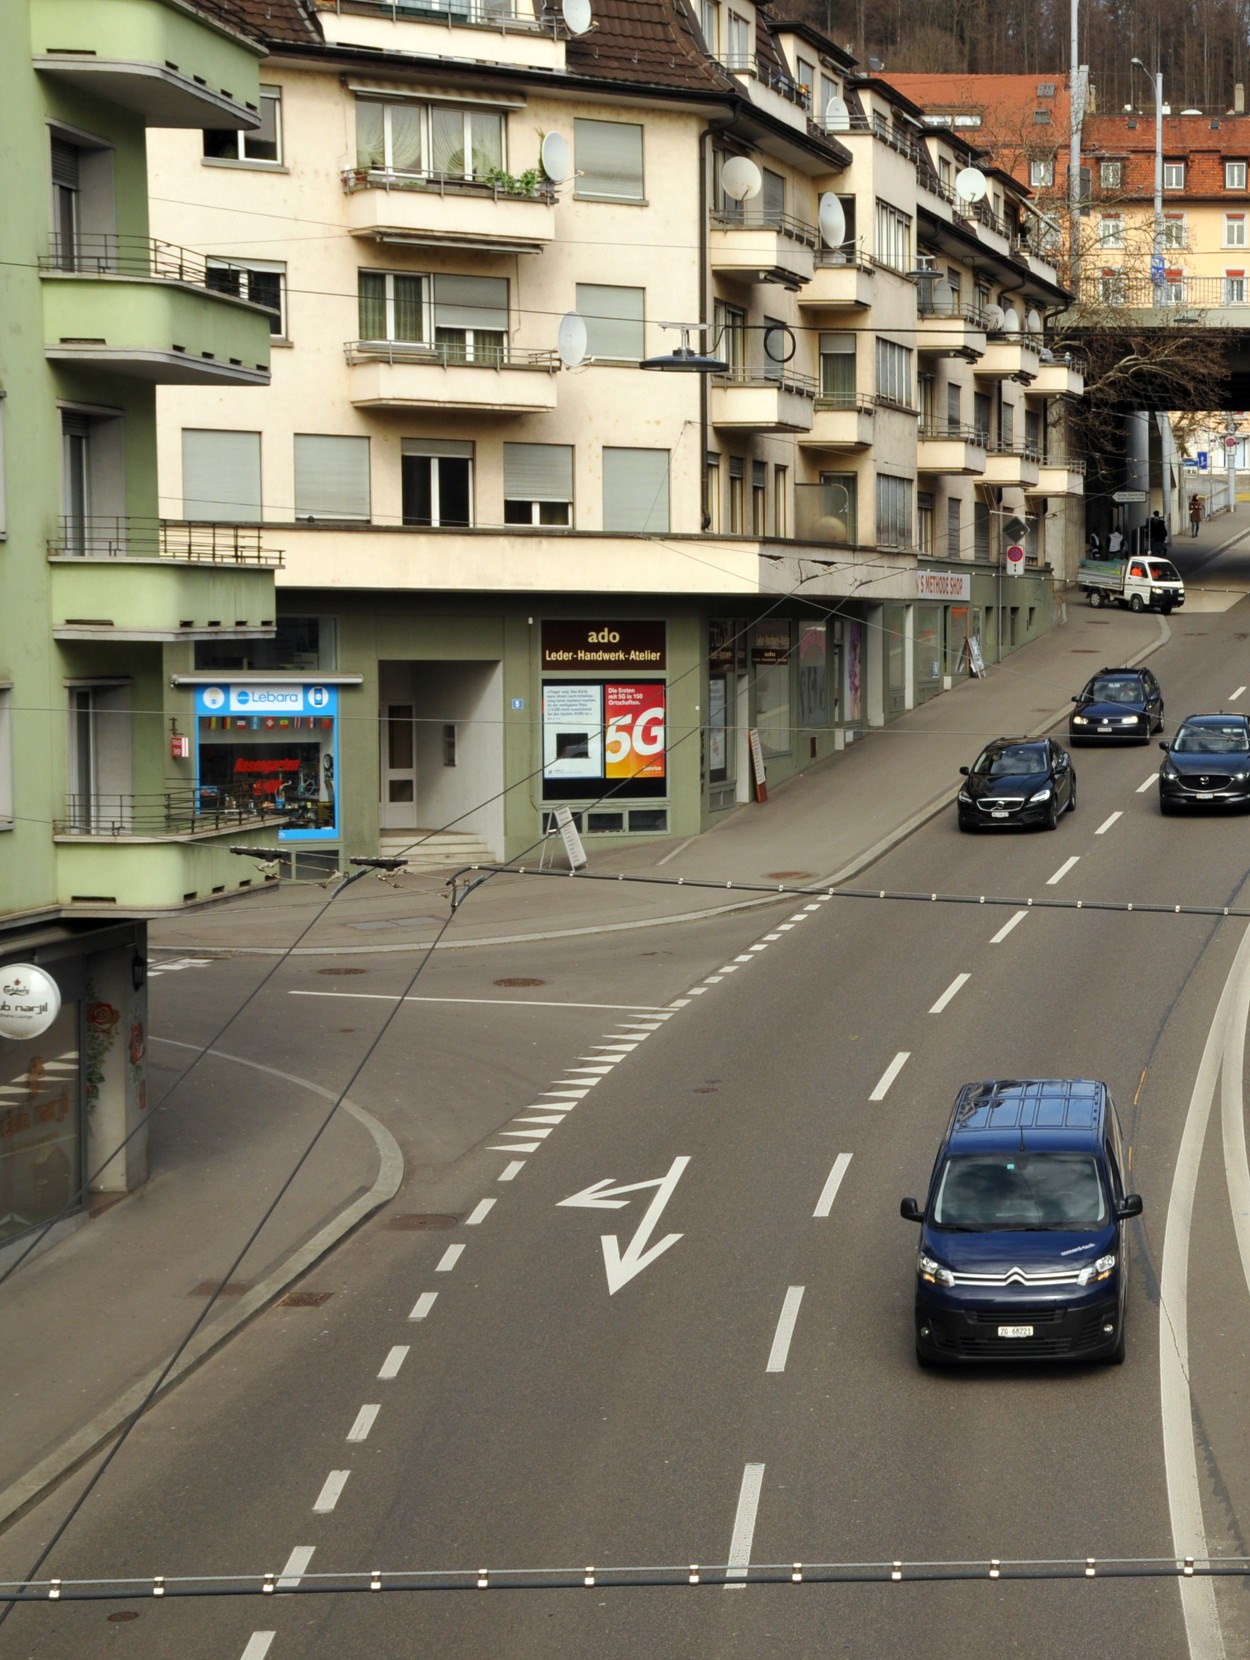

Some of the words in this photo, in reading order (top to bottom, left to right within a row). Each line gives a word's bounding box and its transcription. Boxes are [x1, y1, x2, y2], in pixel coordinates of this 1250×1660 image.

[926, 575, 949, 594] METHODE
[950, 577, 963, 595] SHOP
[588, 627, 619, 643] ado
[545, 650, 660, 661] Leder-Handwerk-Atelier
[251, 691, 299, 703] Lebara
[606, 707, 664, 763] 5G
[15, 1002, 48, 1014] narjil
